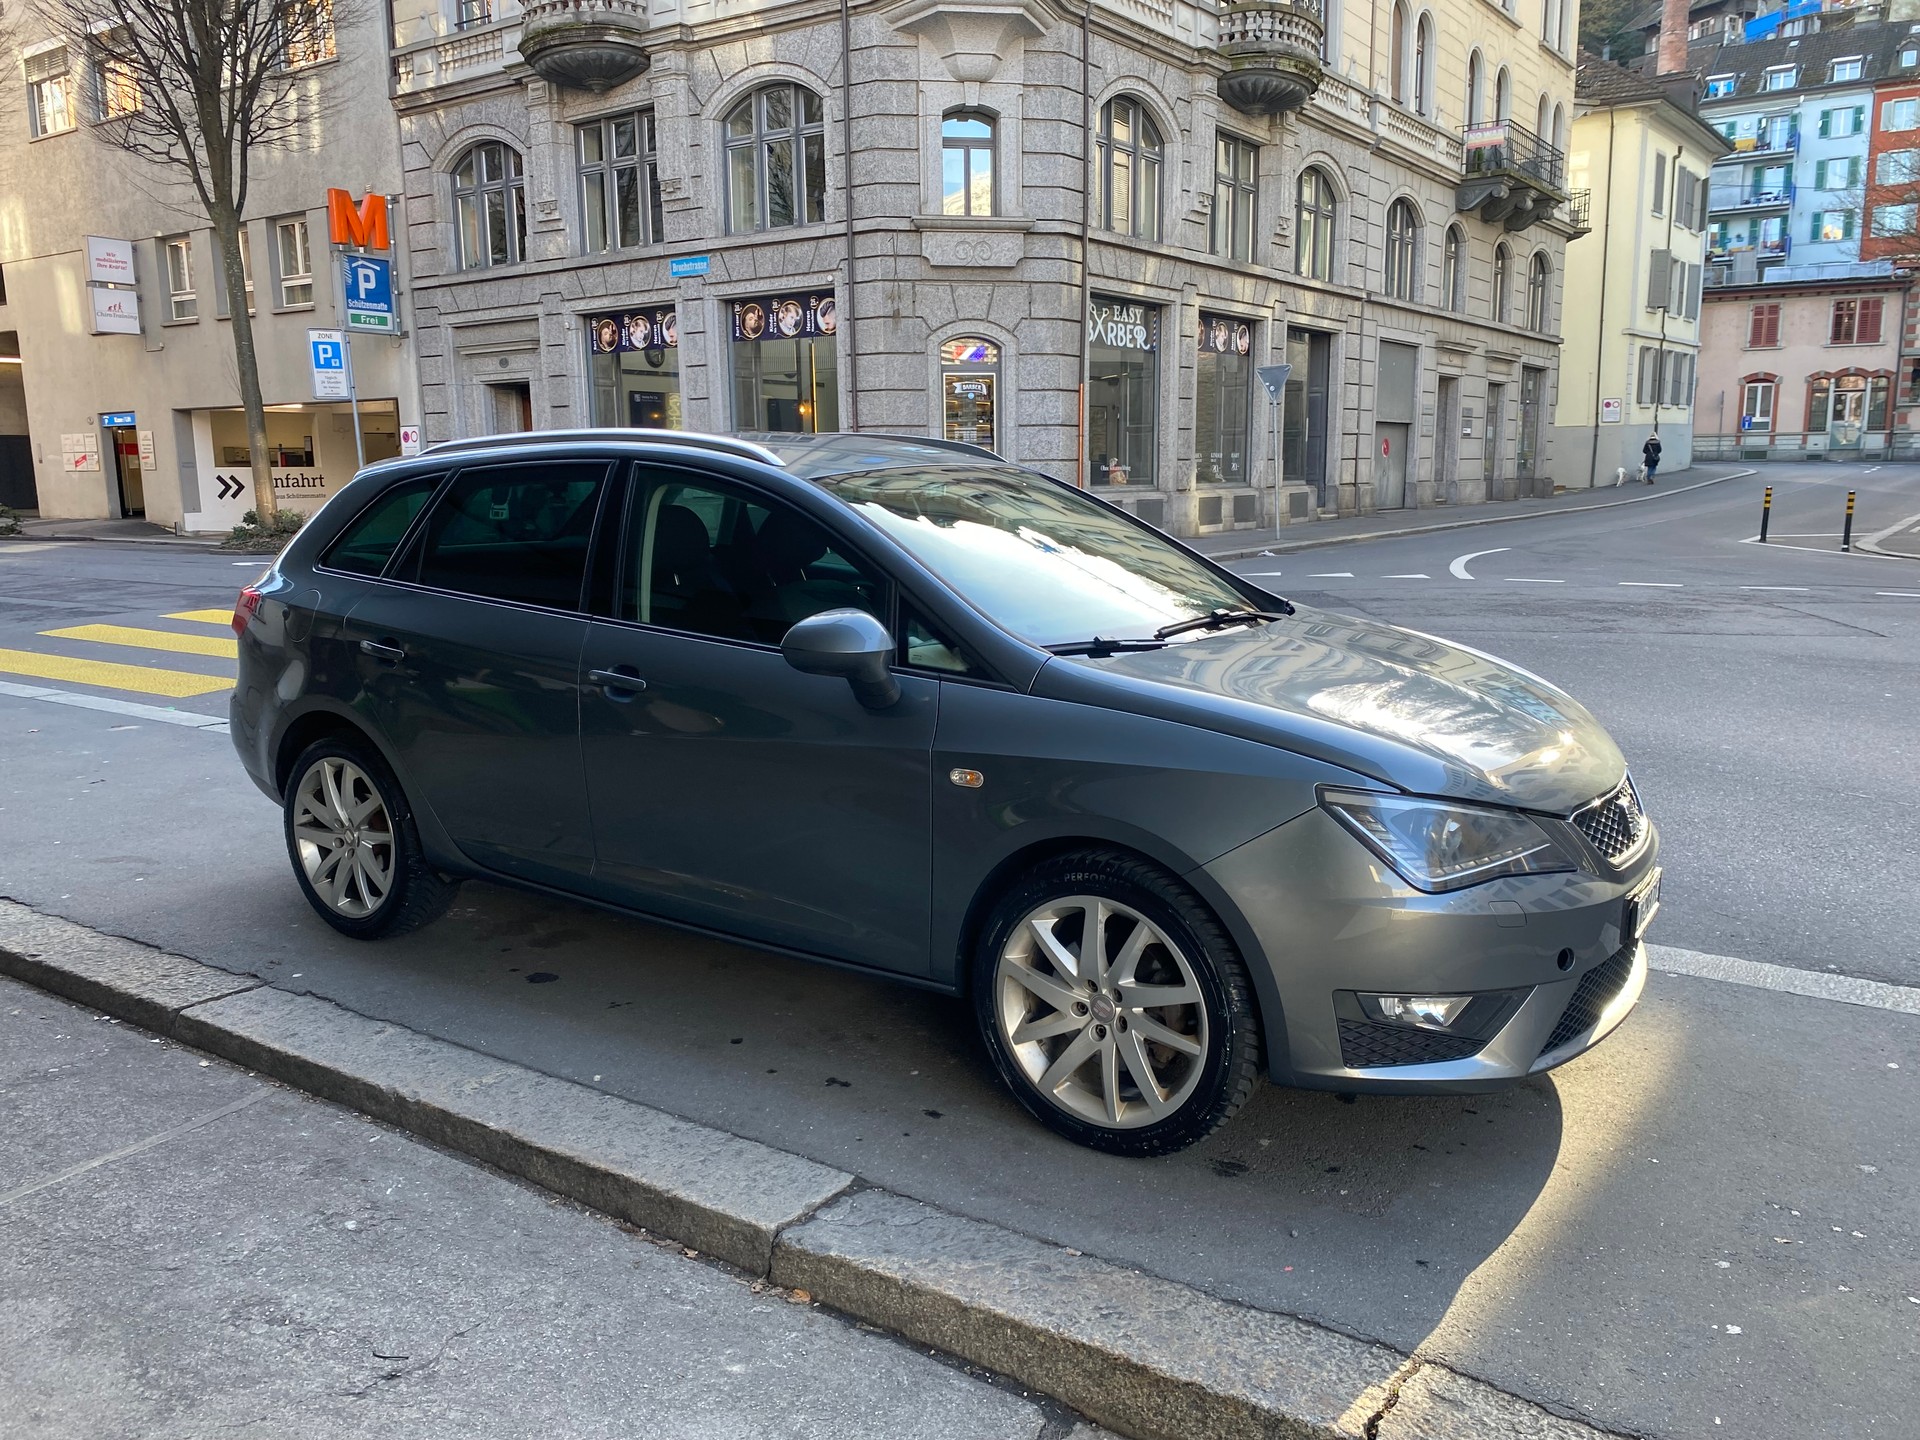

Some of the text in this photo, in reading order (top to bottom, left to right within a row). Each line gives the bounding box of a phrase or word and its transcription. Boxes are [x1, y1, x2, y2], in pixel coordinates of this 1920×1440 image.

[327, 188, 389, 250] M
[357, 267, 376, 299] P
[347, 299, 388, 311] Schützenmatte
[1113, 305, 1143, 324] EASY
[361, 316, 379, 325] Frei
[318, 344, 332, 364] P
[274, 473, 325, 488] nfahrt
